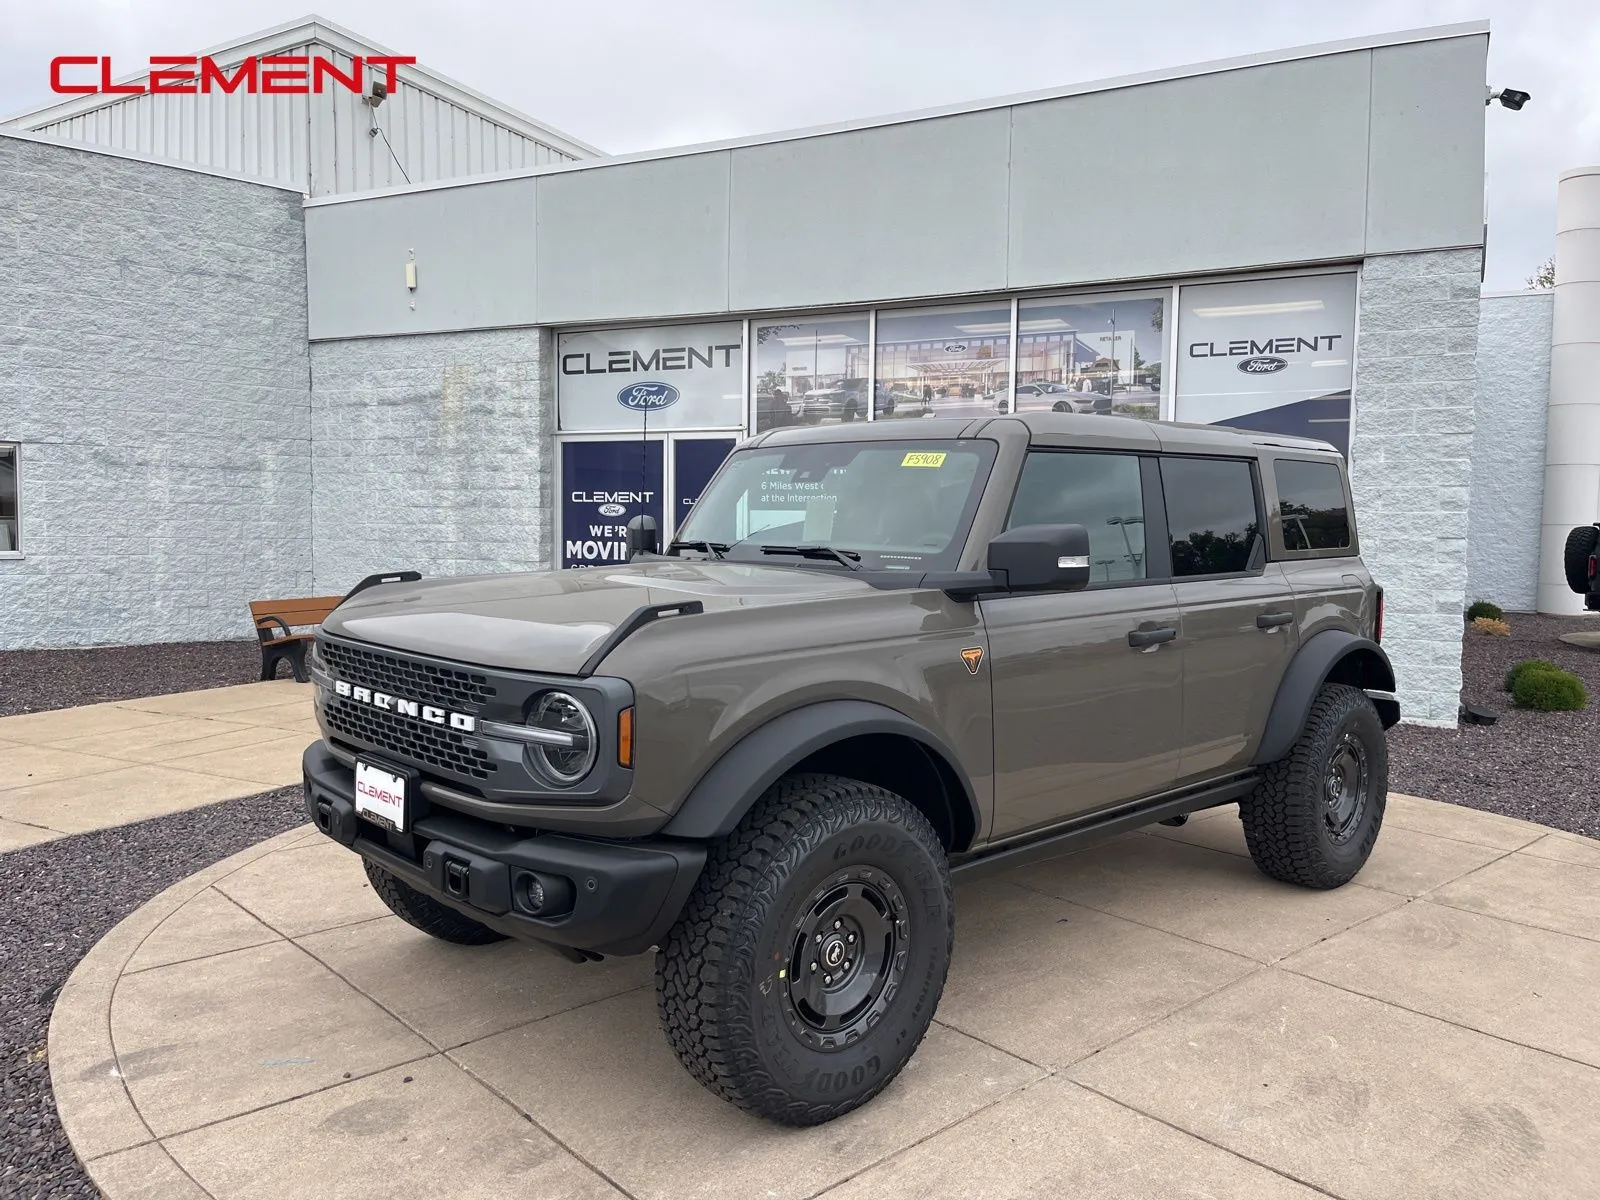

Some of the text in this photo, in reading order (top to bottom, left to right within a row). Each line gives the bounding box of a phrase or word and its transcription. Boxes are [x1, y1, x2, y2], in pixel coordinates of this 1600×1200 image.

[1189, 334, 1342, 358] CLEMENT
[562, 344, 741, 375] CLEMENT
[1246, 358, 1278, 373] Ford
[627, 385, 669, 407] Ford
[906, 453, 942, 465] F5908
[761, 481, 767, 490] 6
[769, 481, 792, 490] Miles
[794, 482, 819, 490] West
[571, 491, 654, 503] CLEMENT
[761, 494, 769, 503] at
[771, 493, 785, 503] the
[603, 505, 621, 515] Ford
[589, 525, 627, 538] WE'R
[335, 680, 475, 732] BRONCO
[357, 781, 403, 808] CLEMENT
[362, 808, 394, 831] CLEMENT
